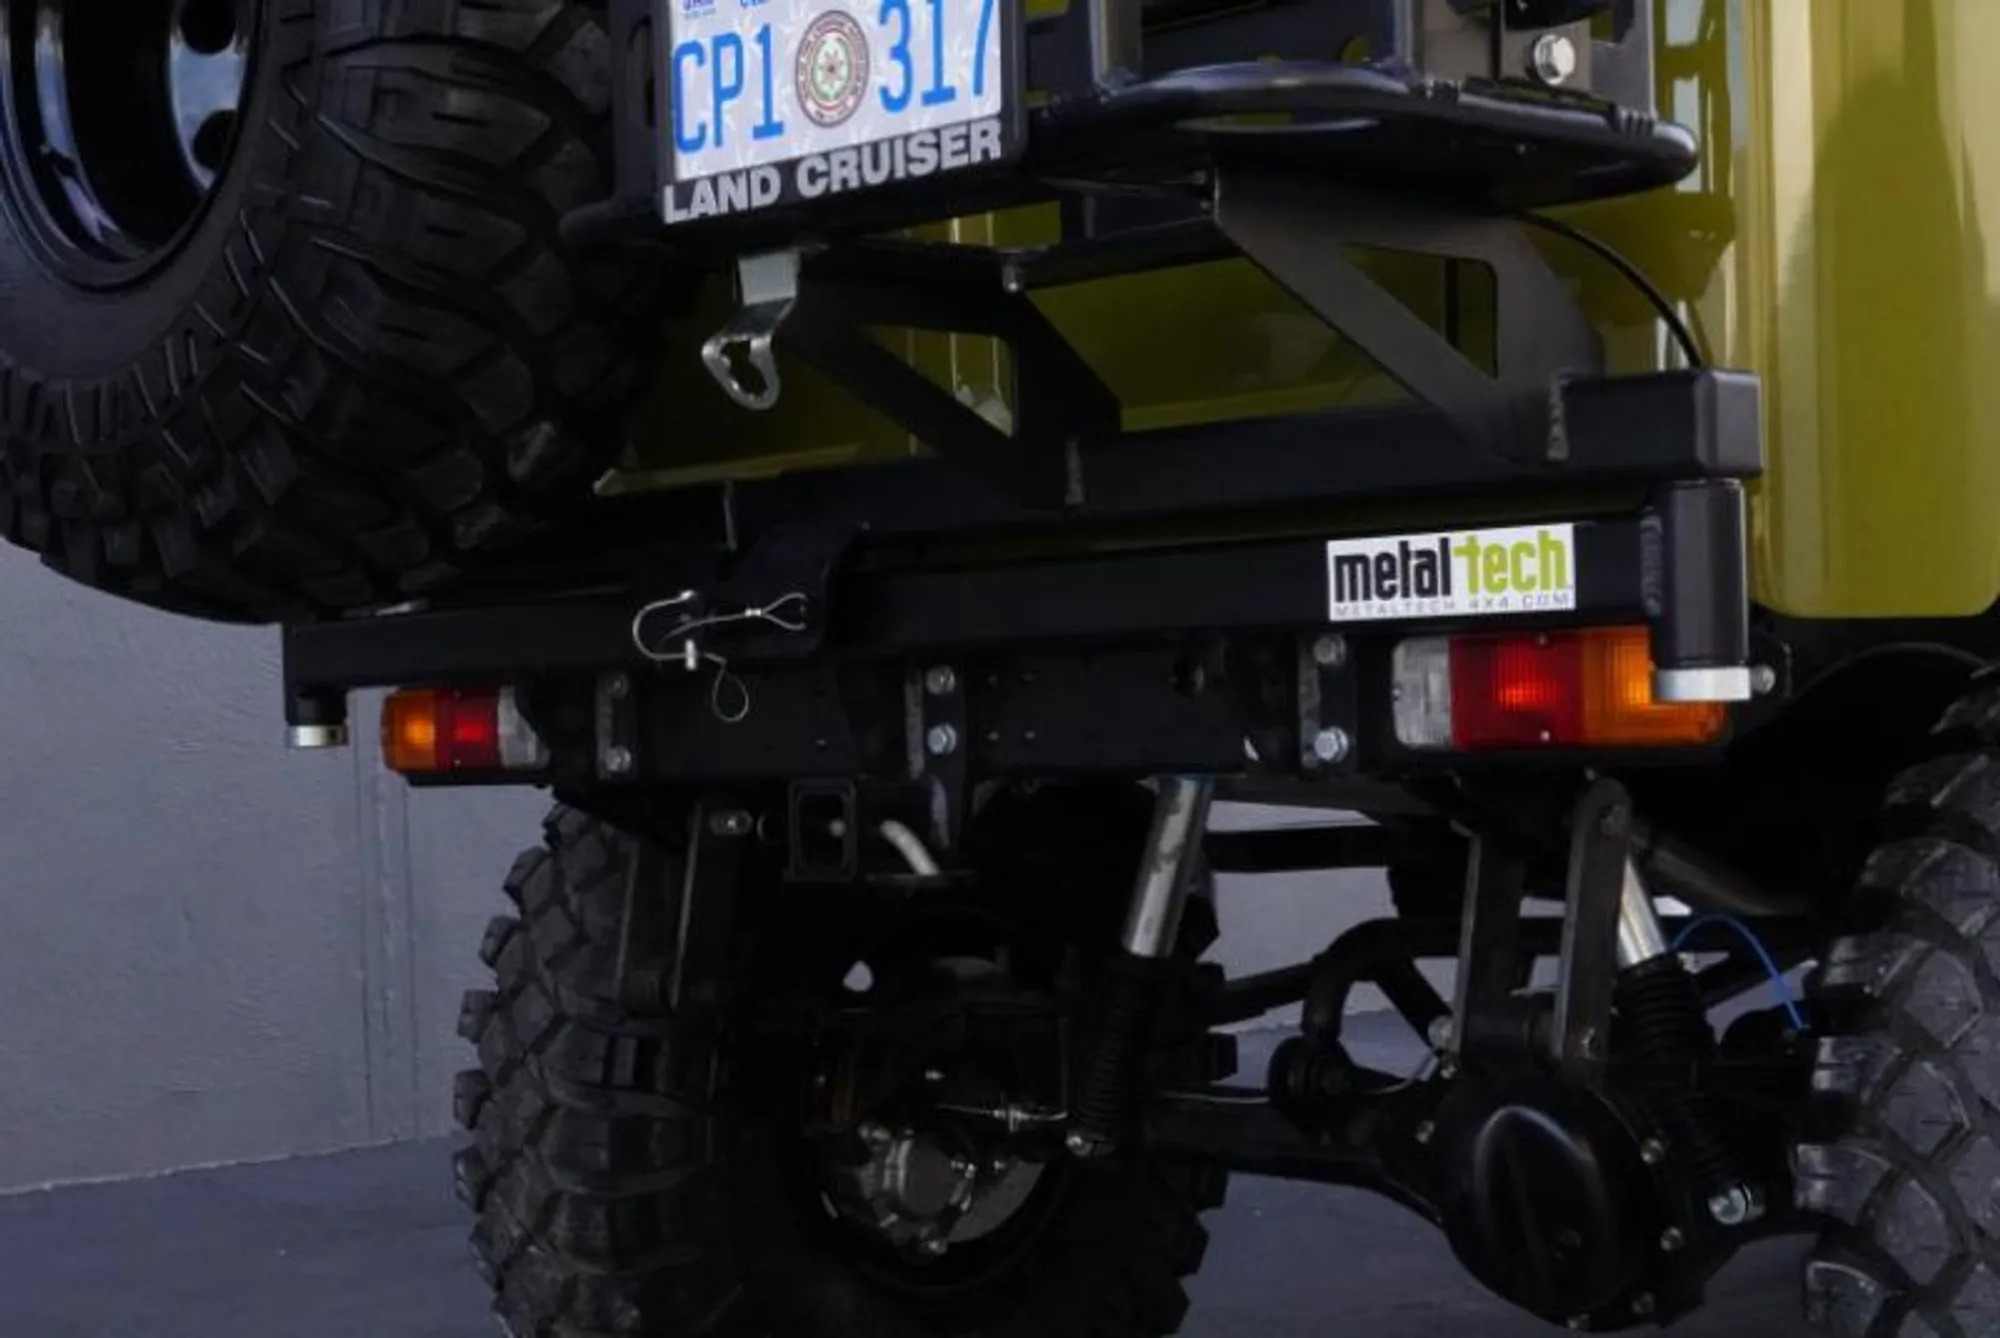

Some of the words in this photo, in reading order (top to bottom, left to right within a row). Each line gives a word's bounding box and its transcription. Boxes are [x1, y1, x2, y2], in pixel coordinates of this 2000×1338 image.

[672, 22, 785, 155] CP1
[878, 0, 995, 113] 317
[663, 166, 781, 224] LAND
[797, 119, 1002, 198] CRUISER
